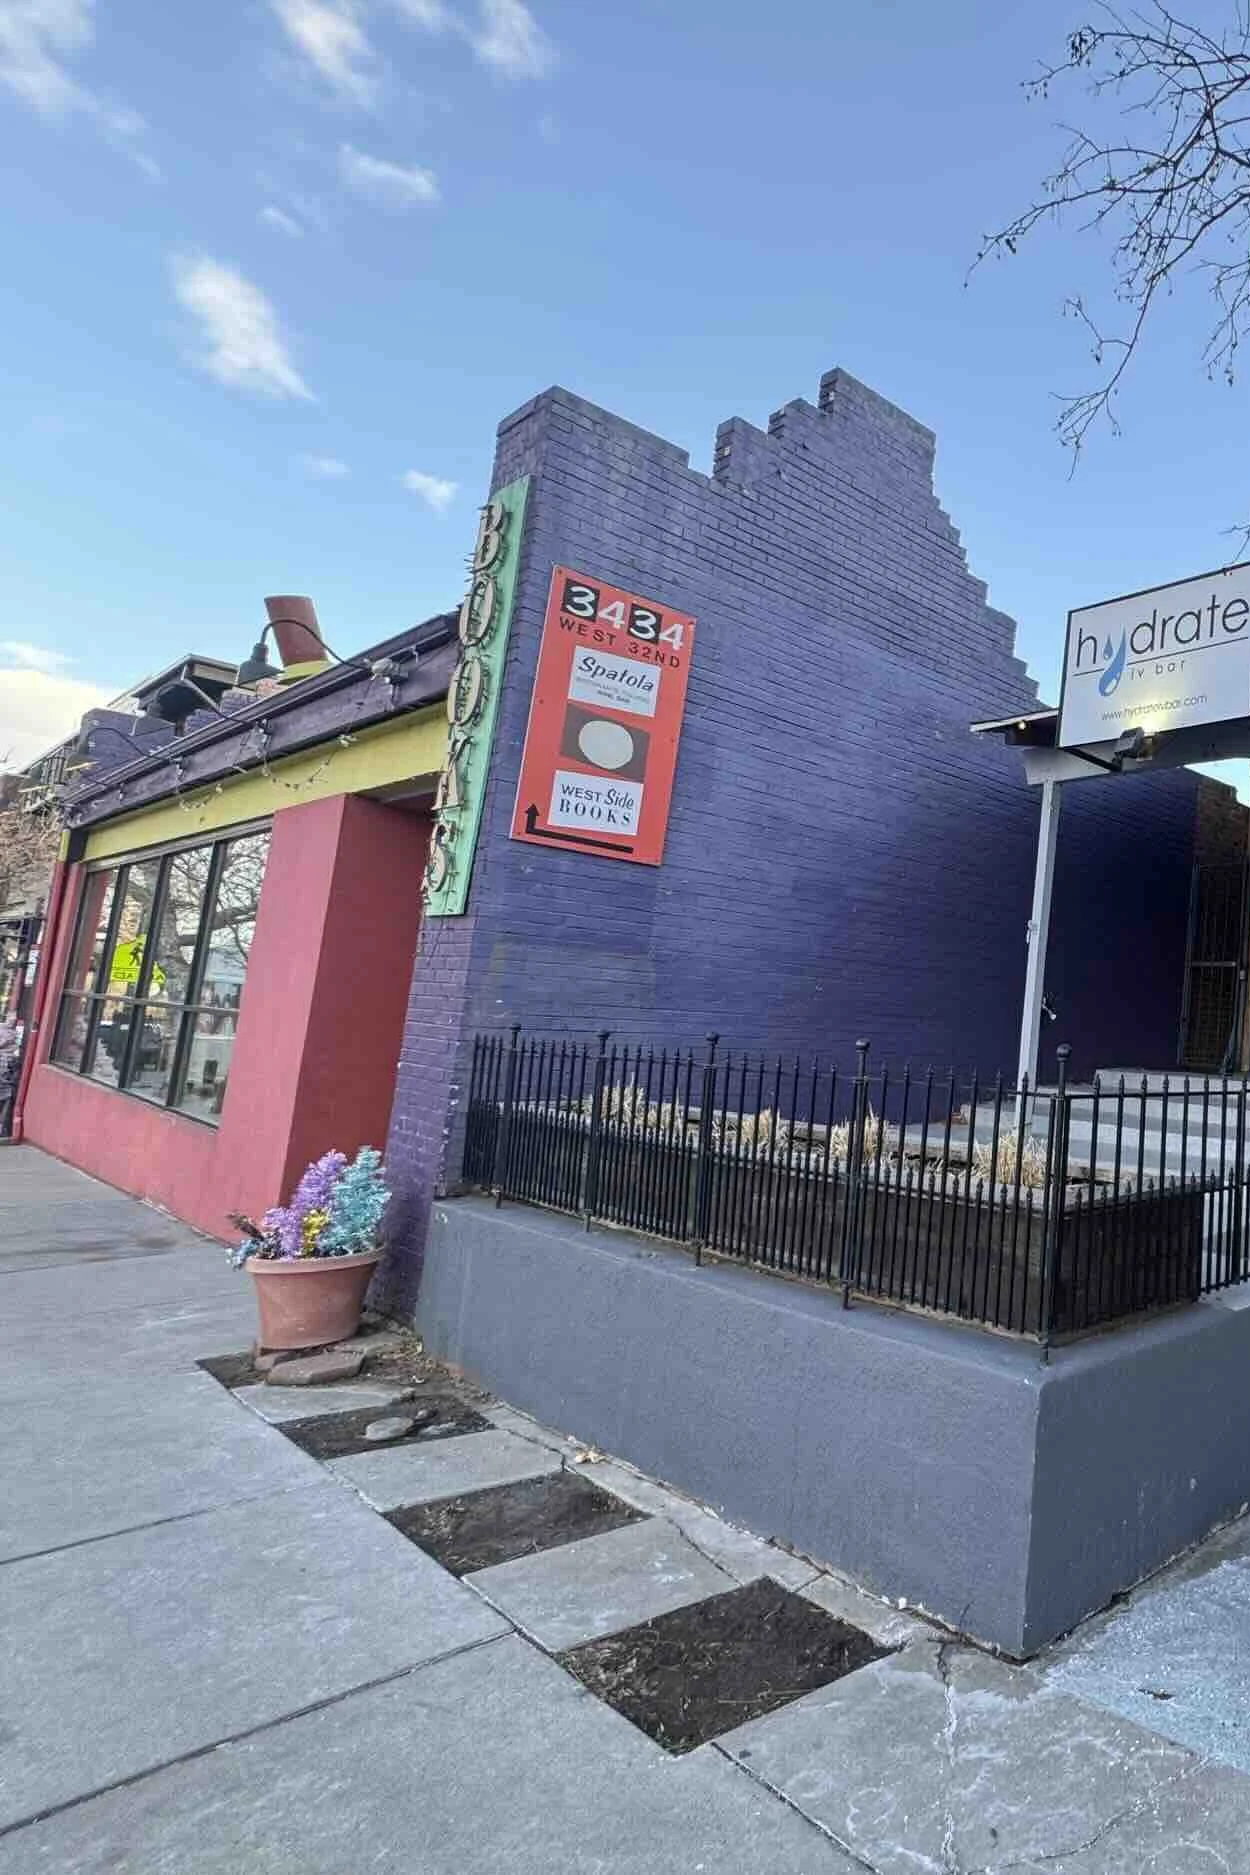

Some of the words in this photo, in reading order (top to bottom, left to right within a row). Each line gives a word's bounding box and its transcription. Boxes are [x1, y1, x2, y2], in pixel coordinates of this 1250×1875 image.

[565, 585, 684, 650] 3434
[559, 616, 617, 646] WEST
[627, 641, 680, 669] 32ND
[1076, 594, 1250, 697] hydrate
[577, 656, 654, 692] Spatola
[1154, 660, 1186, 676] bar
[421, 502, 506, 896] BOOKS
[559, 798, 633, 826] BOOKS
[561, 783, 602, 803] WEST
[603, 788, 635, 810] Side
